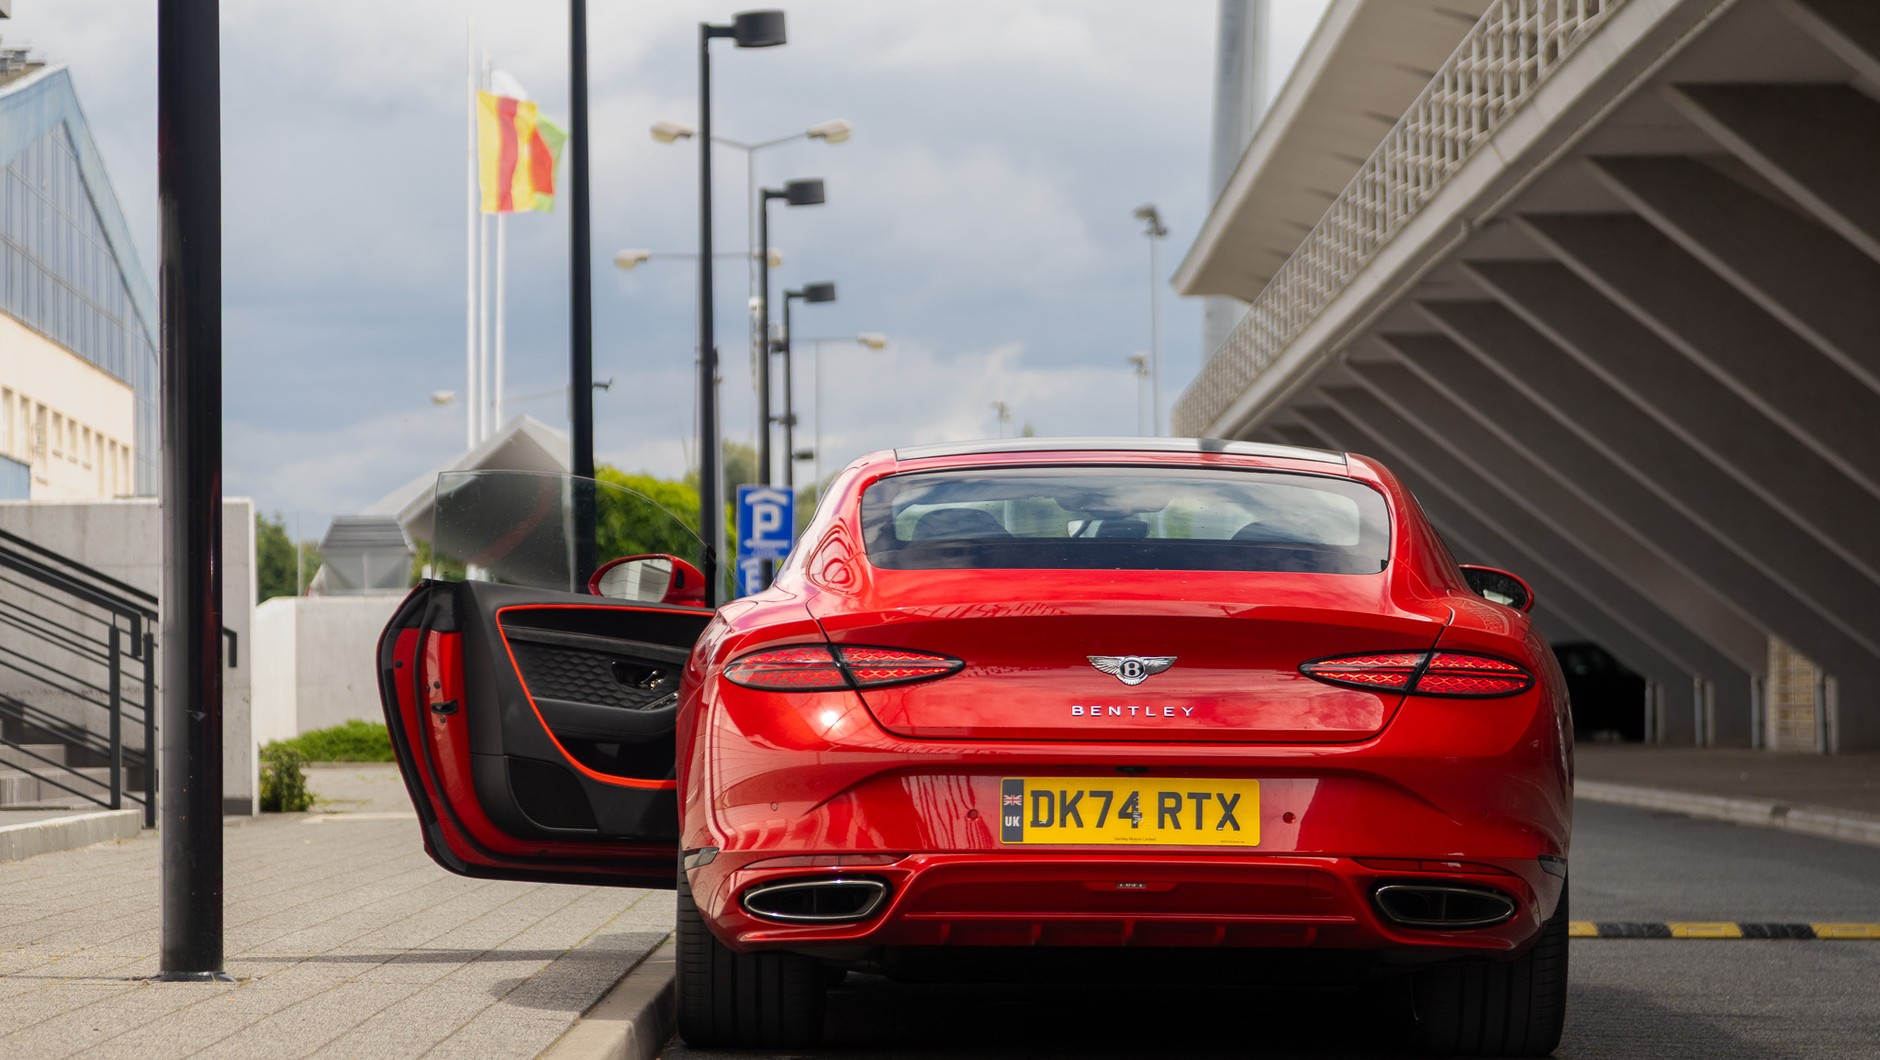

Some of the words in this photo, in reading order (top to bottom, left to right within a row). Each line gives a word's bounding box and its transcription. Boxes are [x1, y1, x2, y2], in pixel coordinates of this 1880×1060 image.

[752, 503, 780, 542] P
[1123, 661, 1141, 677] B
[1071, 705, 1195, 717] BENTLEY
[1030, 790, 1143, 829] DK74
[1157, 791, 1241, 831] RTX
[1004, 816, 1020, 827] UK
